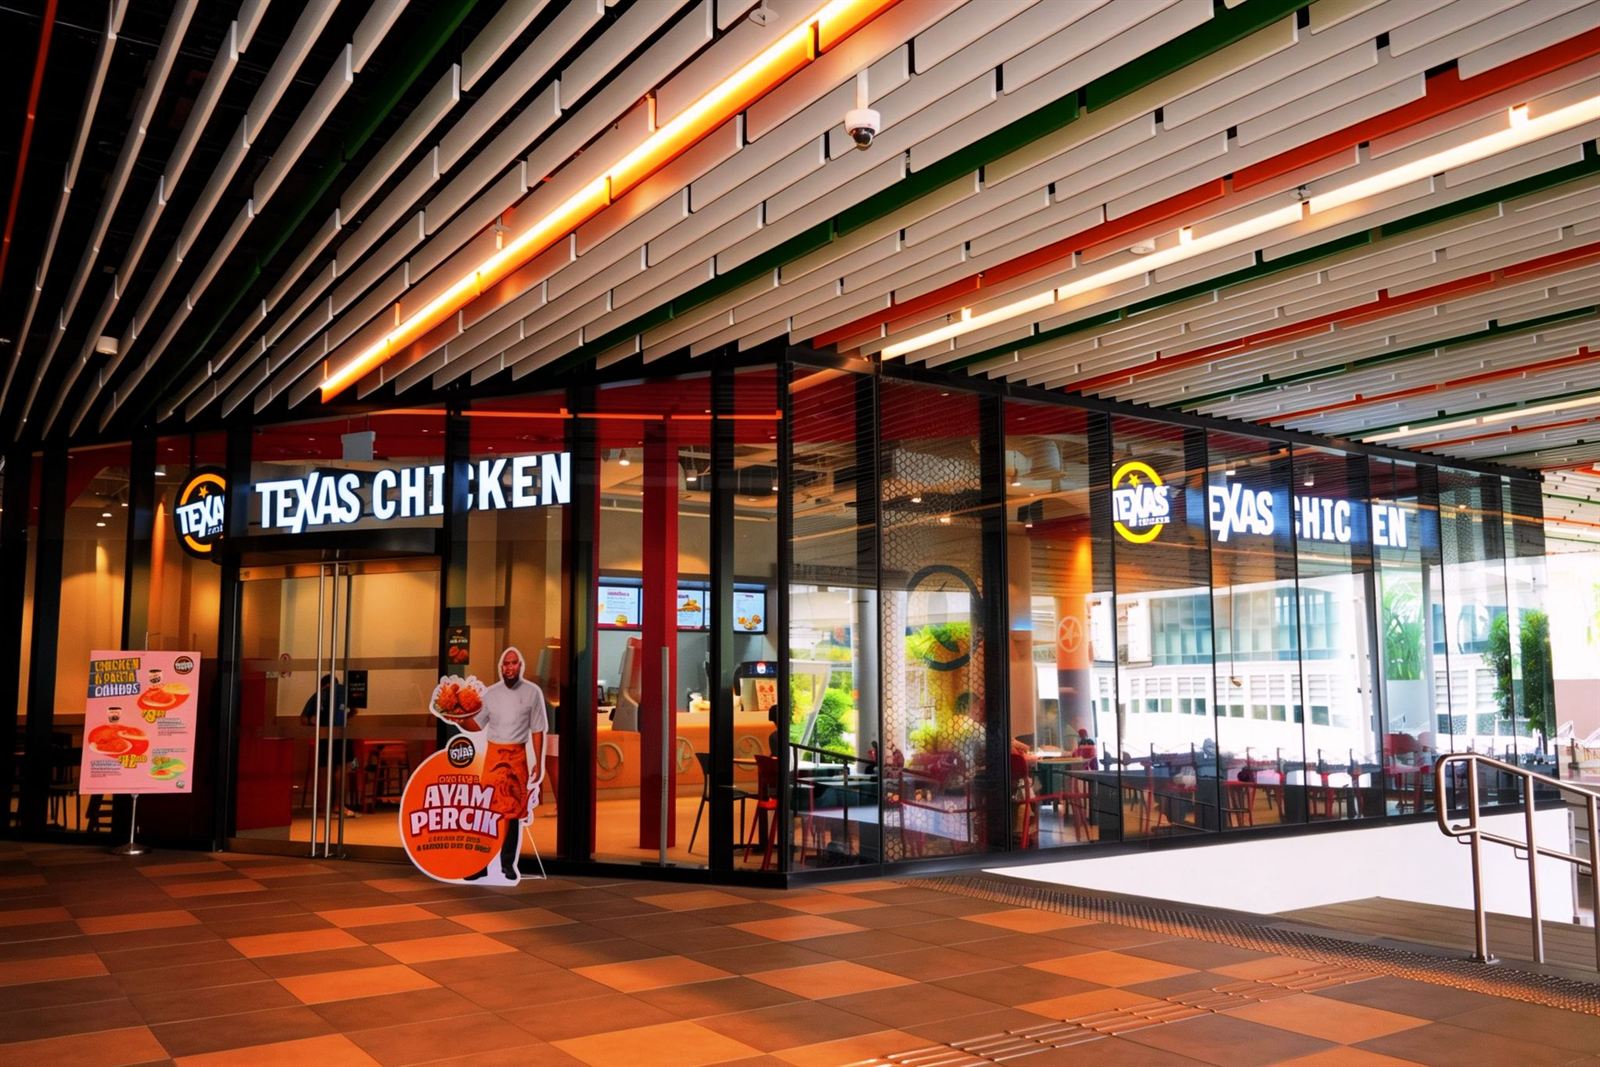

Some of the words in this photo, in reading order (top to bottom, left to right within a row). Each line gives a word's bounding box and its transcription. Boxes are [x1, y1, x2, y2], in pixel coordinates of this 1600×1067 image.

[176, 494, 225, 538] TEXA
[256, 472, 361, 534] TEXAS
[1208, 483, 1275, 542] EXAS
[1294, 495, 1407, 548] HICEN
[424, 783, 494, 809] AYAM
[410, 807, 502, 837] PERCIK
